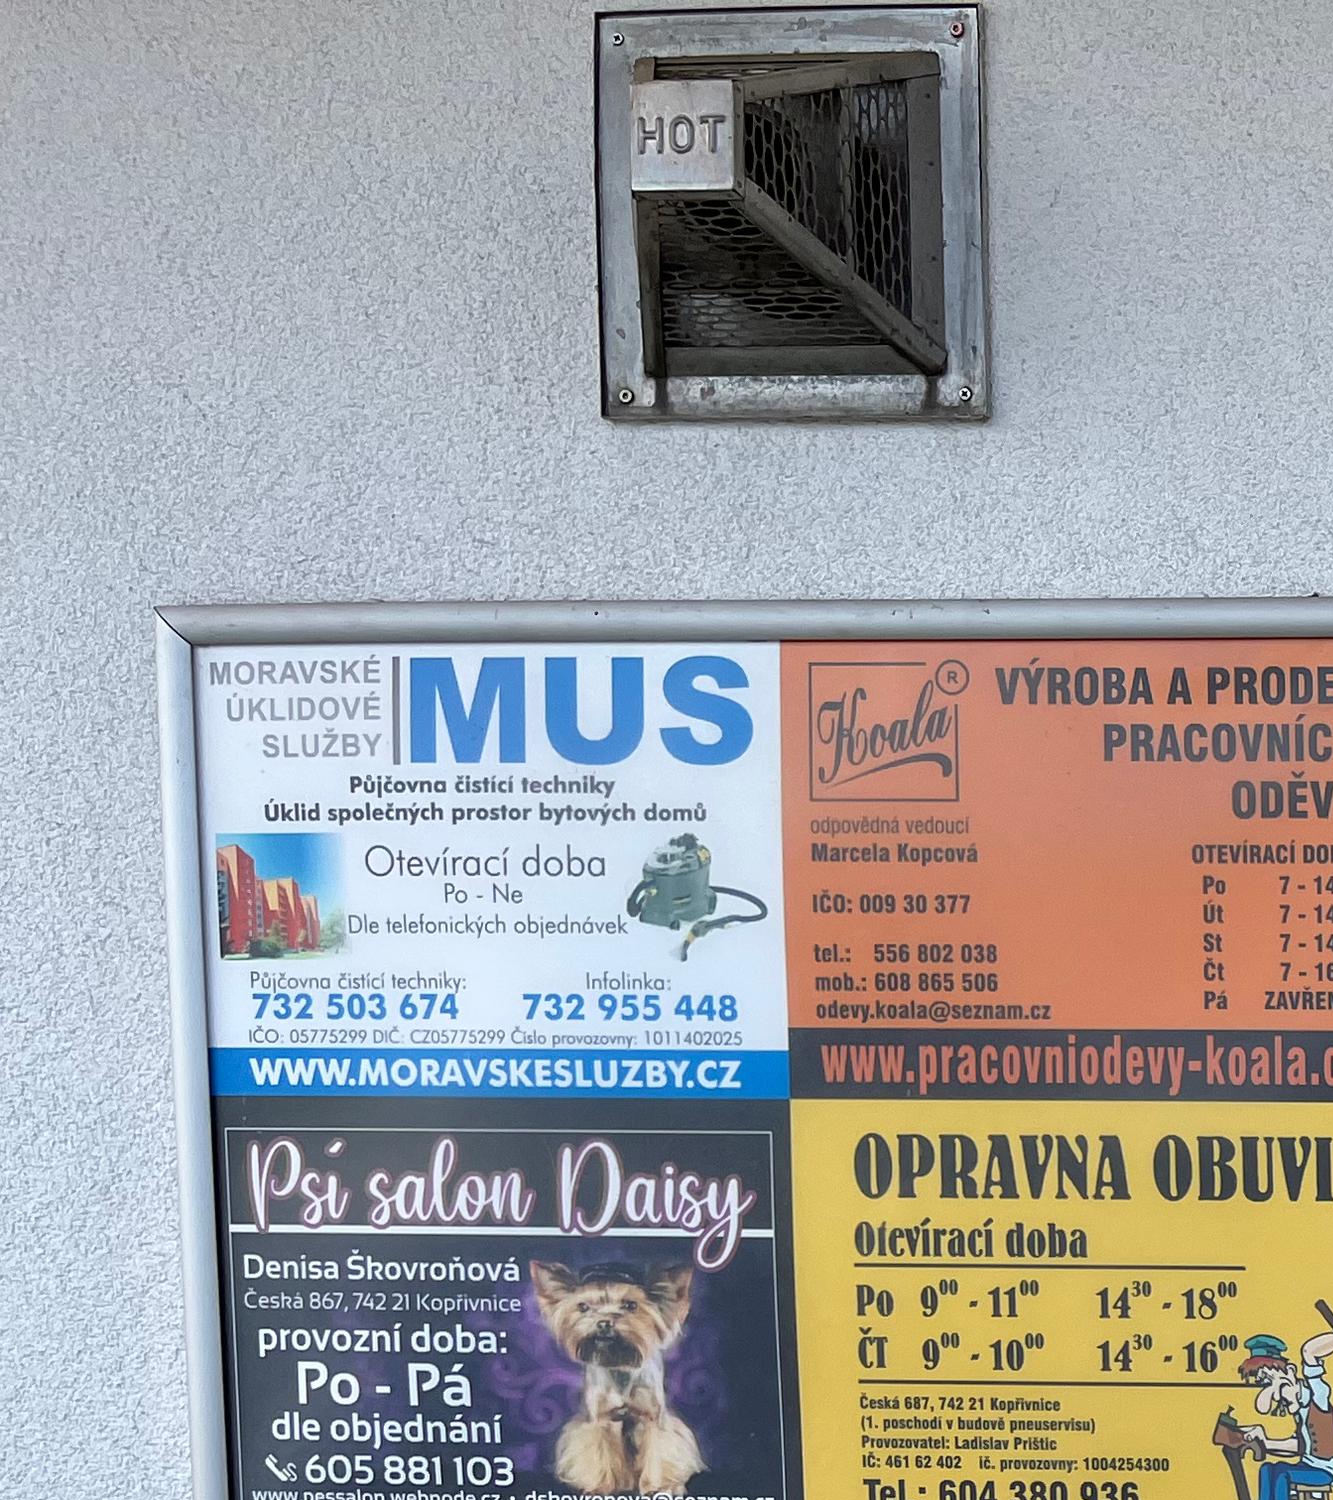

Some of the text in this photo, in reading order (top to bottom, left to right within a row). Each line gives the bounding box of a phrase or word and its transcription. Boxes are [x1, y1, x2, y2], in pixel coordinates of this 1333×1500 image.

[637, 113, 726, 155] HOT
[209, 655, 382, 686] MORAVSKÉ
[995, 657, 1153, 705] VÝROBA
[1167, 667, 1192, 705] A
[225, 691, 382, 722] ÚKLIDOVÉ
[409, 655, 754, 766] MUS
[261, 728, 382, 758] SLUŽBY
[817, 680, 952, 784] Koala
[349, 775, 615, 798] Půjčovna čistící techniky
[264, 801, 707, 825] Úklid společných prostor bytových domů
[810, 816, 970, 837] odpovědná vedoucí
[364, 844, 606, 878] Otevírací doba
[811, 842, 979, 867] Marcela Kopcová
[1191, 839, 1296, 865] OTEVÍRACÍ
[443, 883, 468, 904] Po
[492, 884, 523, 904] Ne
[1202, 875, 1227, 895] Po
[1279, 875, 1290, 895] 7
[812, 889, 971, 914] IČO: 009 30 377
[1203, 900, 1225, 924] Út
[1279, 904, 1291, 924] 7
[348, 914, 628, 939] Dle telefonických objednávek
[814, 943, 998, 963] tel.: 556 802 038
[1203, 933, 1223, 953] St
[1279, 933, 1291, 953] 7
[250, 971, 467, 994] Půjčovna čistící techniky:
[585, 972, 672, 992] Infolinka:
[815, 972, 999, 992] mob.: 608 865 506
[1203, 957, 1225, 982] Čt
[1280, 962, 1292, 982] 7
[252, 994, 459, 1021] 732 503 674
[522, 994, 738, 1022] 732 955 448
[816, 1000, 1052, 1024] odevy.koala@seznam.cz
[1203, 990, 1228, 1010] Pá
[248, 1025, 743, 1048] IČO: 05775299 DIČ: CZ05775299 Číslo provozovny: 1011402025
[249, 1057, 742, 1089] WWW.MORAVSKESLUZBY.CZ
[853, 1132, 1131, 1201] OPRAVNA
[249, 1137, 755, 1270] Psí salon Daisy
[854, 1217, 1088, 1259] Otevírací doba
[243, 1249, 521, 1282] Denisa Škovroňová
[244, 1288, 522, 1315] Česká 867, 742 21 Kopřivnice
[855, 1284, 894, 1317] Po
[258, 1323, 508, 1358] provozní doba:
[857, 1327, 889, 1369] ČT
[297, 1361, 360, 1405] Po
[407, 1362, 473, 1407] Pá
[860, 1392, 1061, 1414] Česká 687, 742 21 Kopřivnice
[271, 1411, 503, 1450] dle objednání
[861, 1416, 1096, 1435] (1. poschodí v budově pneuservisu)
[861, 1435, 1057, 1451] Provozovatel: Ladislav Prištic
[305, 1454, 515, 1486] 605 881 103
[862, 1451, 881, 1469] IČ:
[885, 1455, 911, 1469] 461
[915, 1455, 932, 1469] 62
[936, 1456, 962, 1469] 402
[1000, 1458, 1079, 1473] provozovny:
[1082, 1457, 1170, 1472] 1004254300
